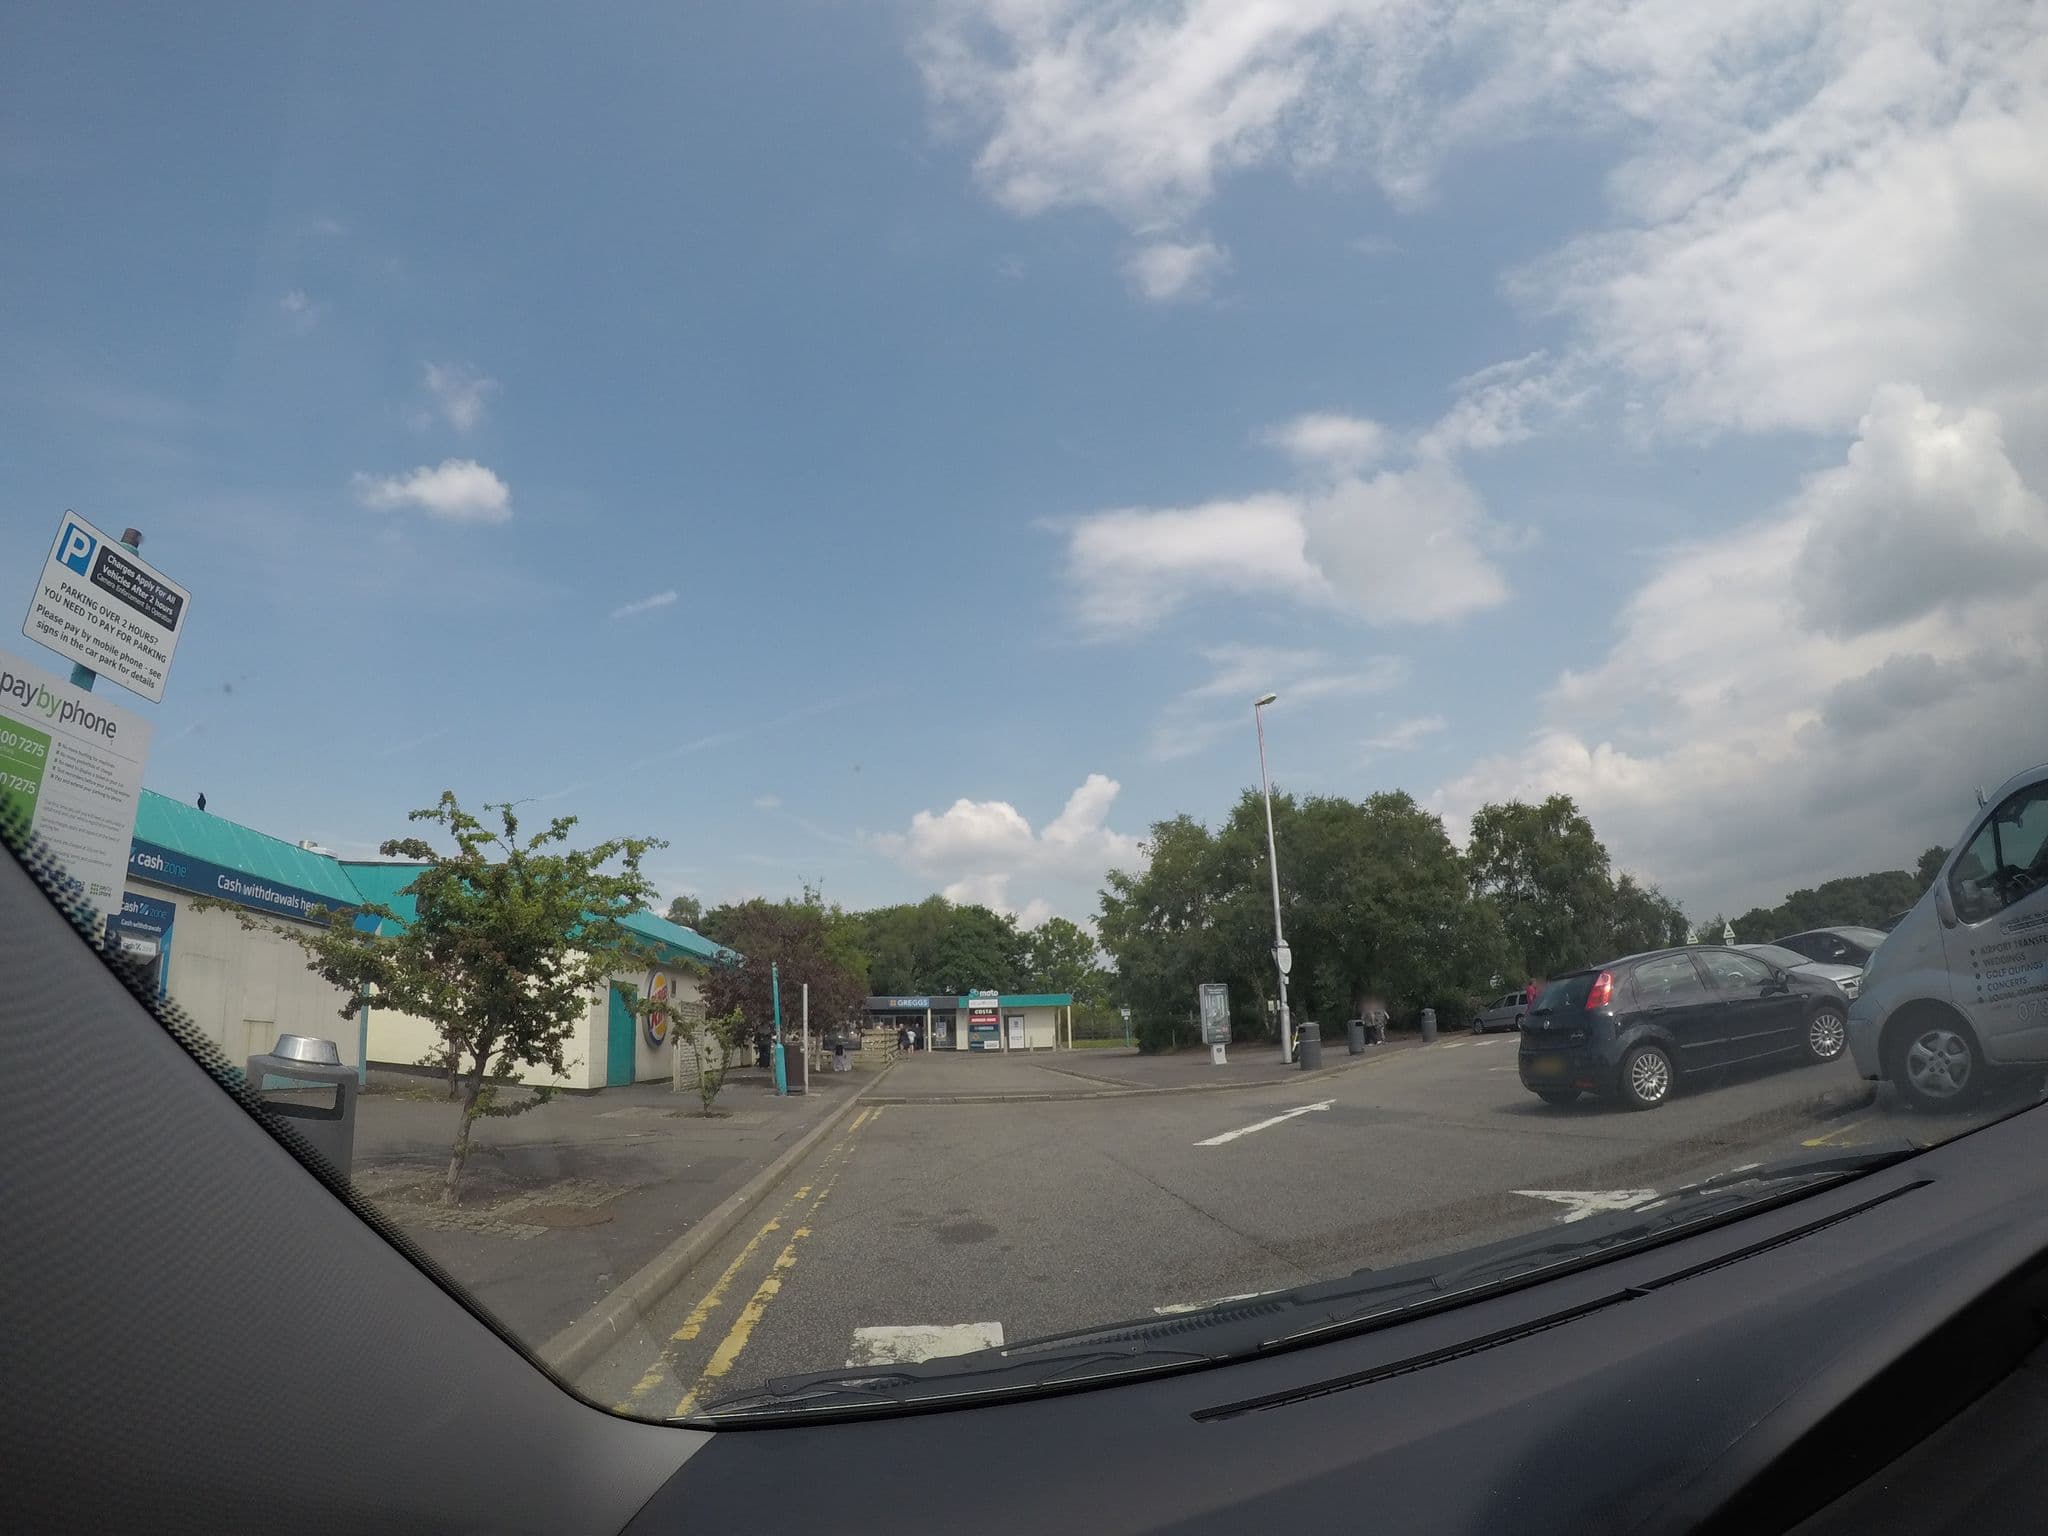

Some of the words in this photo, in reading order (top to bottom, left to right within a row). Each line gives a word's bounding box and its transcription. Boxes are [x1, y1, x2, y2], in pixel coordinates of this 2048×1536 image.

[61, 527, 91, 564] P
[102, 565, 131, 589] Vehicles
[130, 584, 150, 600] After
[149, 595, 156, 604] 2
[155, 600, 173, 615] hours
[107, 555, 135, 577] Charges
[135, 574, 156, 592] Apply
[155, 586, 167, 598] For
[166, 594, 177, 605] All
[44, 586, 62, 603] YOU
[62, 598, 86, 617] NEED
[87, 611, 98, 624] TO
[98, 619, 116, 634] PAY
[116, 630, 133, 644] FOR
[133, 638, 168, 664] PARKING
[60, 581, 99, 611] PARKING
[99, 606, 121, 624] OVER
[121, 619, 128, 629] 2
[128, 622, 159, 646] HOURS?
[35, 620, 59, 637] signs
[60, 632, 69, 643] in
[70, 636, 84, 651] the
[85, 646, 99, 658] car
[99, 653, 118, 669] park
[118, 663, 131, 675] for
[130, 669, 155, 689] details
[36, 603, 64, 626] Please
[64, 621, 81, 636] pay
[81, 629, 92, 642] by
[92, 636, 119, 657] mobile
[120, 651, 143, 670] phone
[149, 668, 162, 680] see
[0, 671, 117, 739] paybyphone
[0, 729, 17, 746] 00
[18, 736, 45, 757] 7275
[9, 775, 37, 794] 7275
[217, 874, 242, 894] Cash
[243, 883, 300, 909] withdrawals
[300, 897, 319, 912] her
[121, 918, 133, 928] Cash
[133, 922, 162, 933] withdrawals
[1986, 967, 2008, 979] GOLF
[2008, 960, 2044, 975] OUTINGS
[1987, 976, 2028, 992] CONCERTS
[897, 999, 929, 1007] GREGGS
[979, 989, 999, 997] moto
